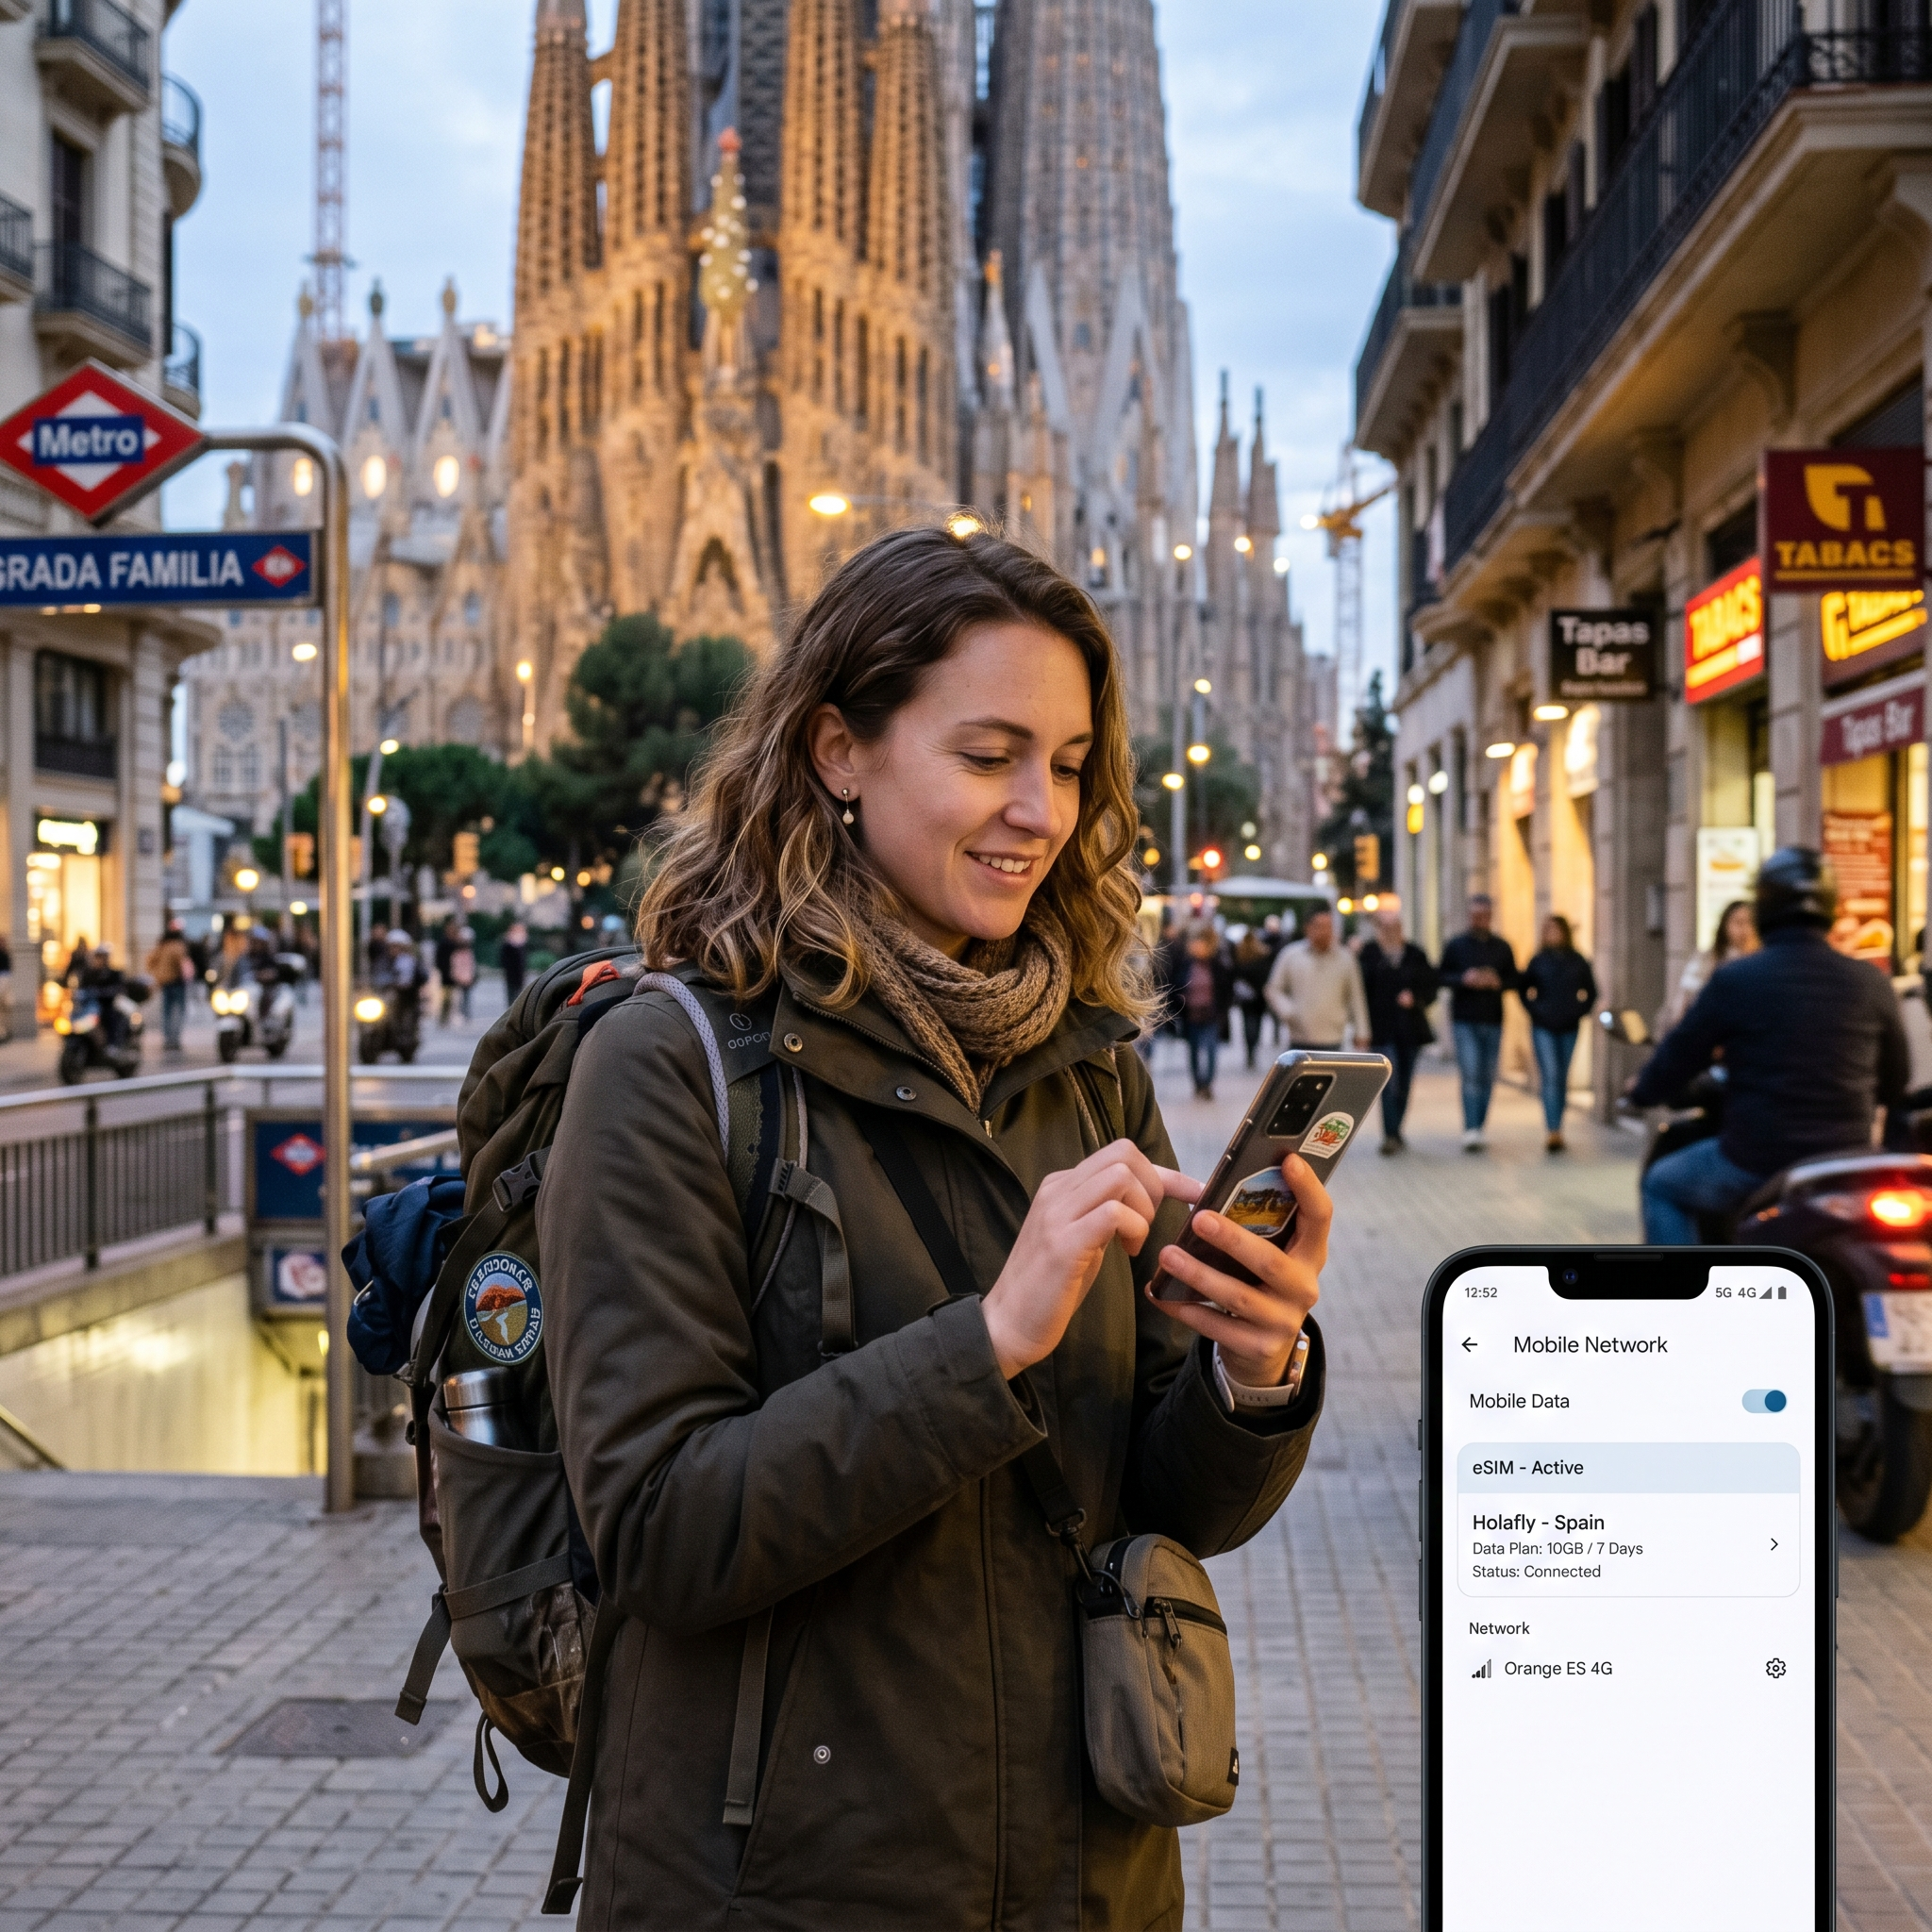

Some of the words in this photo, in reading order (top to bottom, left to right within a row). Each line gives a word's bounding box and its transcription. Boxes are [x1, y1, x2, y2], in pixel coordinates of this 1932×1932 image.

[39, 424, 140, 458] Metro
[1774, 539, 1915, 568] TABACS
[0, 553, 102, 591] RADA
[108, 550, 244, 589] FAMILIA
[1557, 615, 1650, 650] Tapas
[1575, 647, 1632, 675] Bar
[1464, 1287, 1498, 1299] 12:52
[1715, 1287, 1732, 1299] 5G
[1738, 1287, 1757, 1299] 4G
[1514, 1335, 1580, 1354] Mobile
[1585, 1335, 1669, 1354] Network
[1470, 1392, 1527, 1409] Mobile
[1531, 1393, 1570, 1409] Data
[1472, 1459, 1514, 1475] eSIM
[1531, 1458, 1585, 1475] Active
[1473, 1513, 1537, 1534] Holafly
[1554, 1513, 1605, 1535] Spain
[1473, 1541, 1506, 1556] Data
[1509, 1541, 1542, 1556] Plan:
[1546, 1541, 1584, 1556] 10GB
[1587, 1541, 1593, 1556] /
[1596, 1541, 1606, 1556] 7
[1608, 1541, 1644, 1558] Days
[1472, 1564, 1520, 1578] Status:
[1524, 1564, 1602, 1578] Connected
[1469, 1621, 1531, 1636] Network
[1504, 1660, 1562, 1679] Orange
[1566, 1660, 1587, 1676] ES
[1590, 1660, 1613, 1675] 4G
